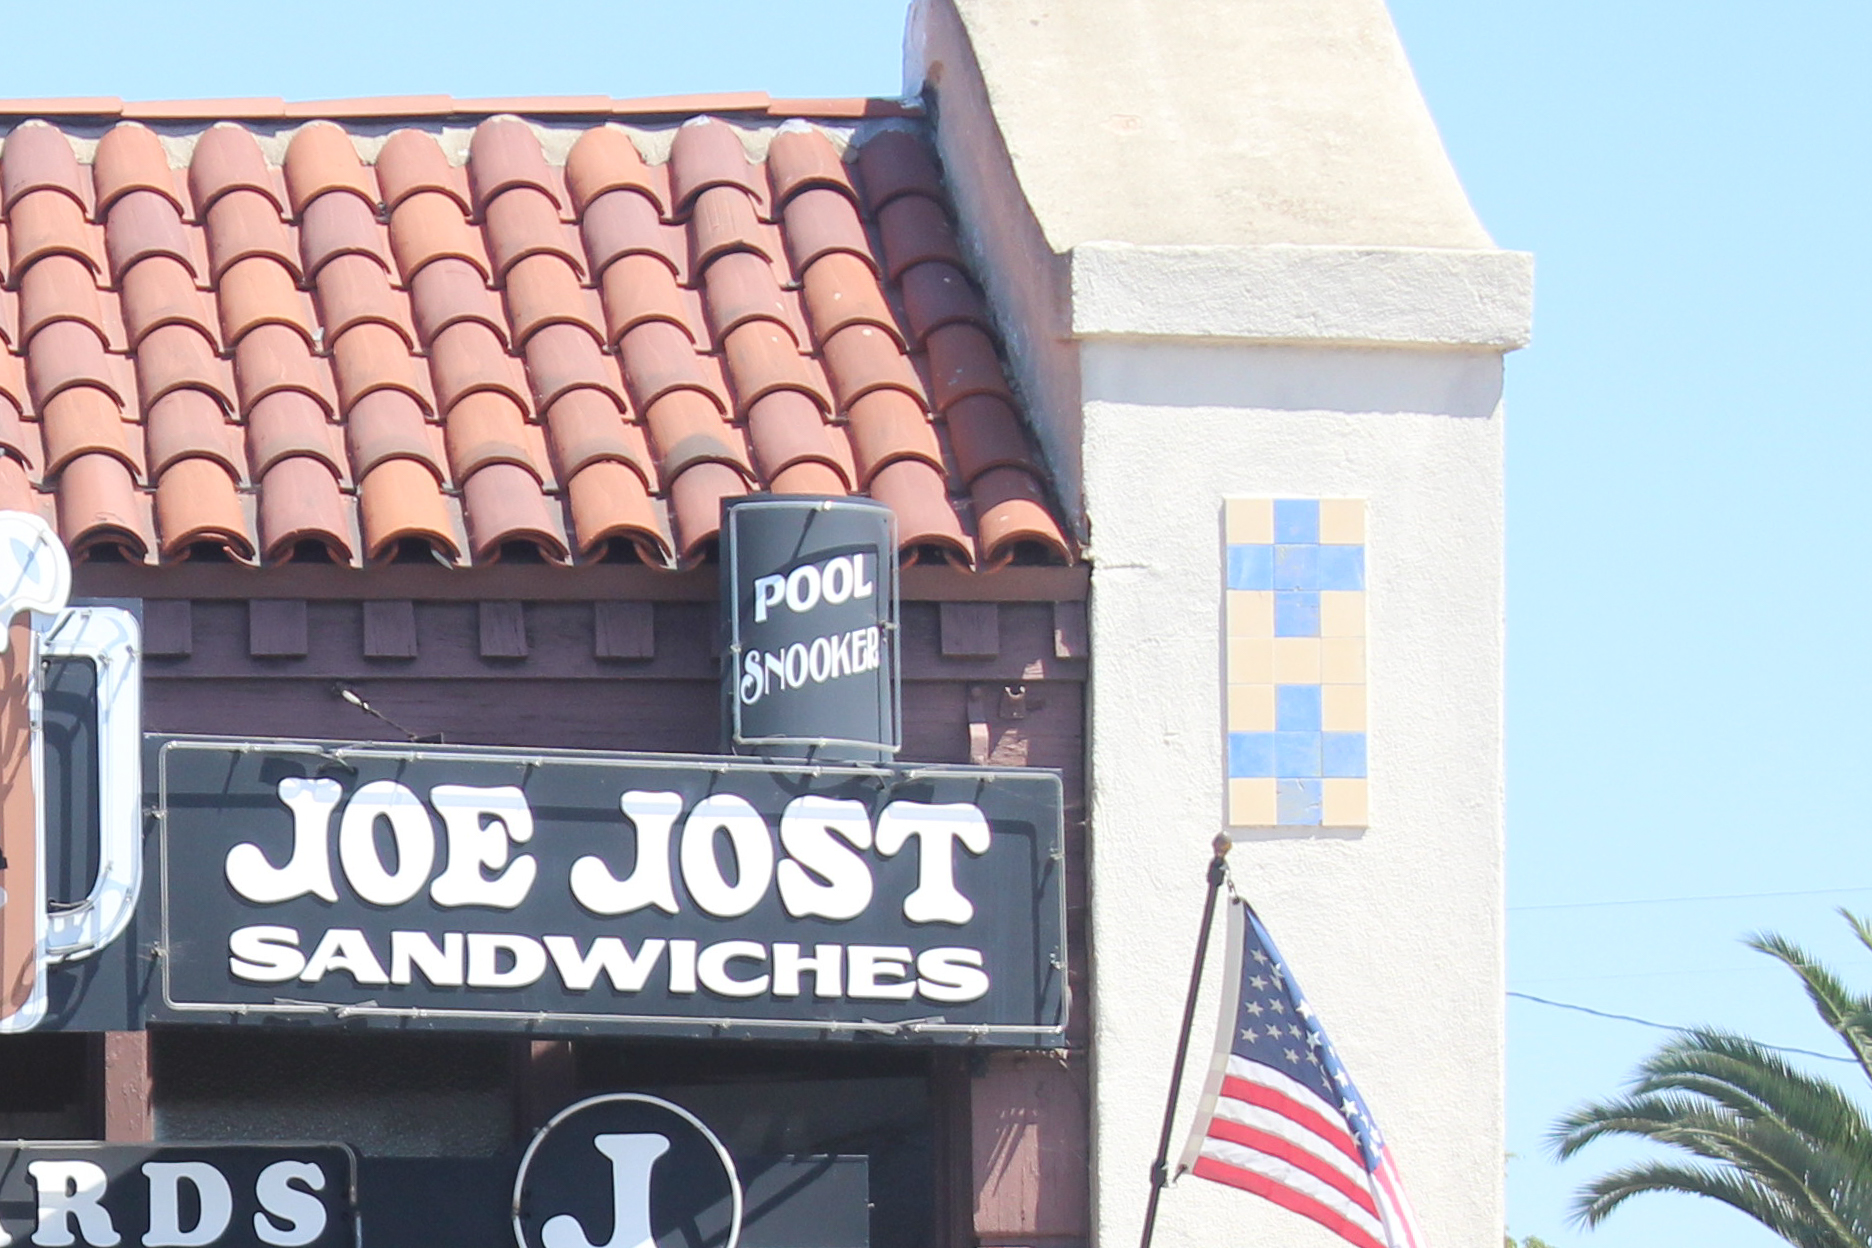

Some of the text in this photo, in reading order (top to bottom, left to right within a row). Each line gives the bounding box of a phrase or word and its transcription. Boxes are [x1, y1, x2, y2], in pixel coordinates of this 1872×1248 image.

[754, 553, 873, 623] POOL
[740, 626, 880, 706] SNOOKER
[225, 778, 992, 925] JOE JOST
[229, 925, 991, 1001] SANDWICHES
